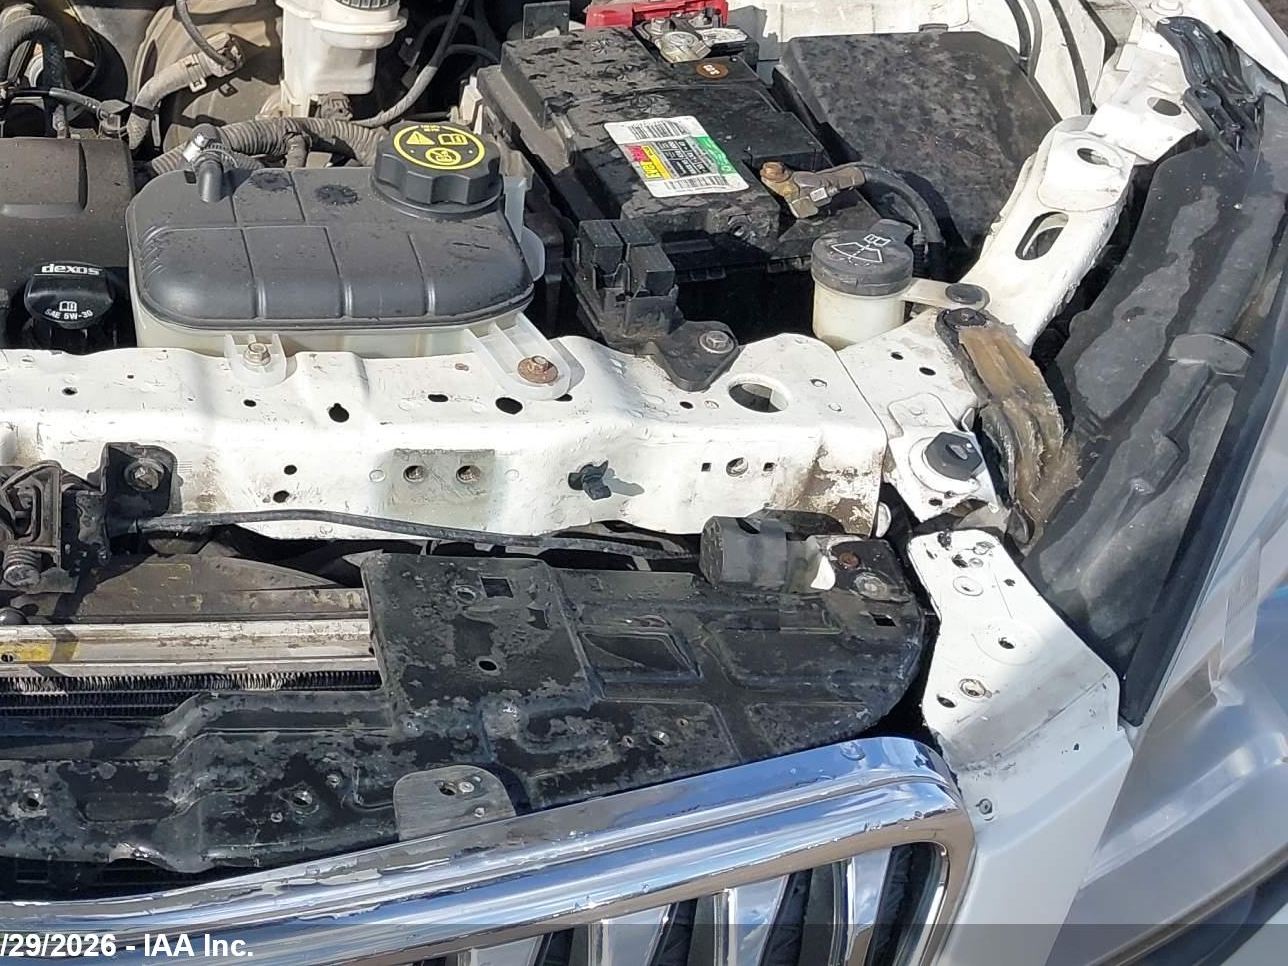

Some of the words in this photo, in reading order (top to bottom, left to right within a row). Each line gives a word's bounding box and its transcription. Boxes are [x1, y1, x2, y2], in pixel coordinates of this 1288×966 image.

[41, 263, 102, 275] dexos
[44, 308, 61, 319] SAE
[63, 309, 94, 320] 5W-30
